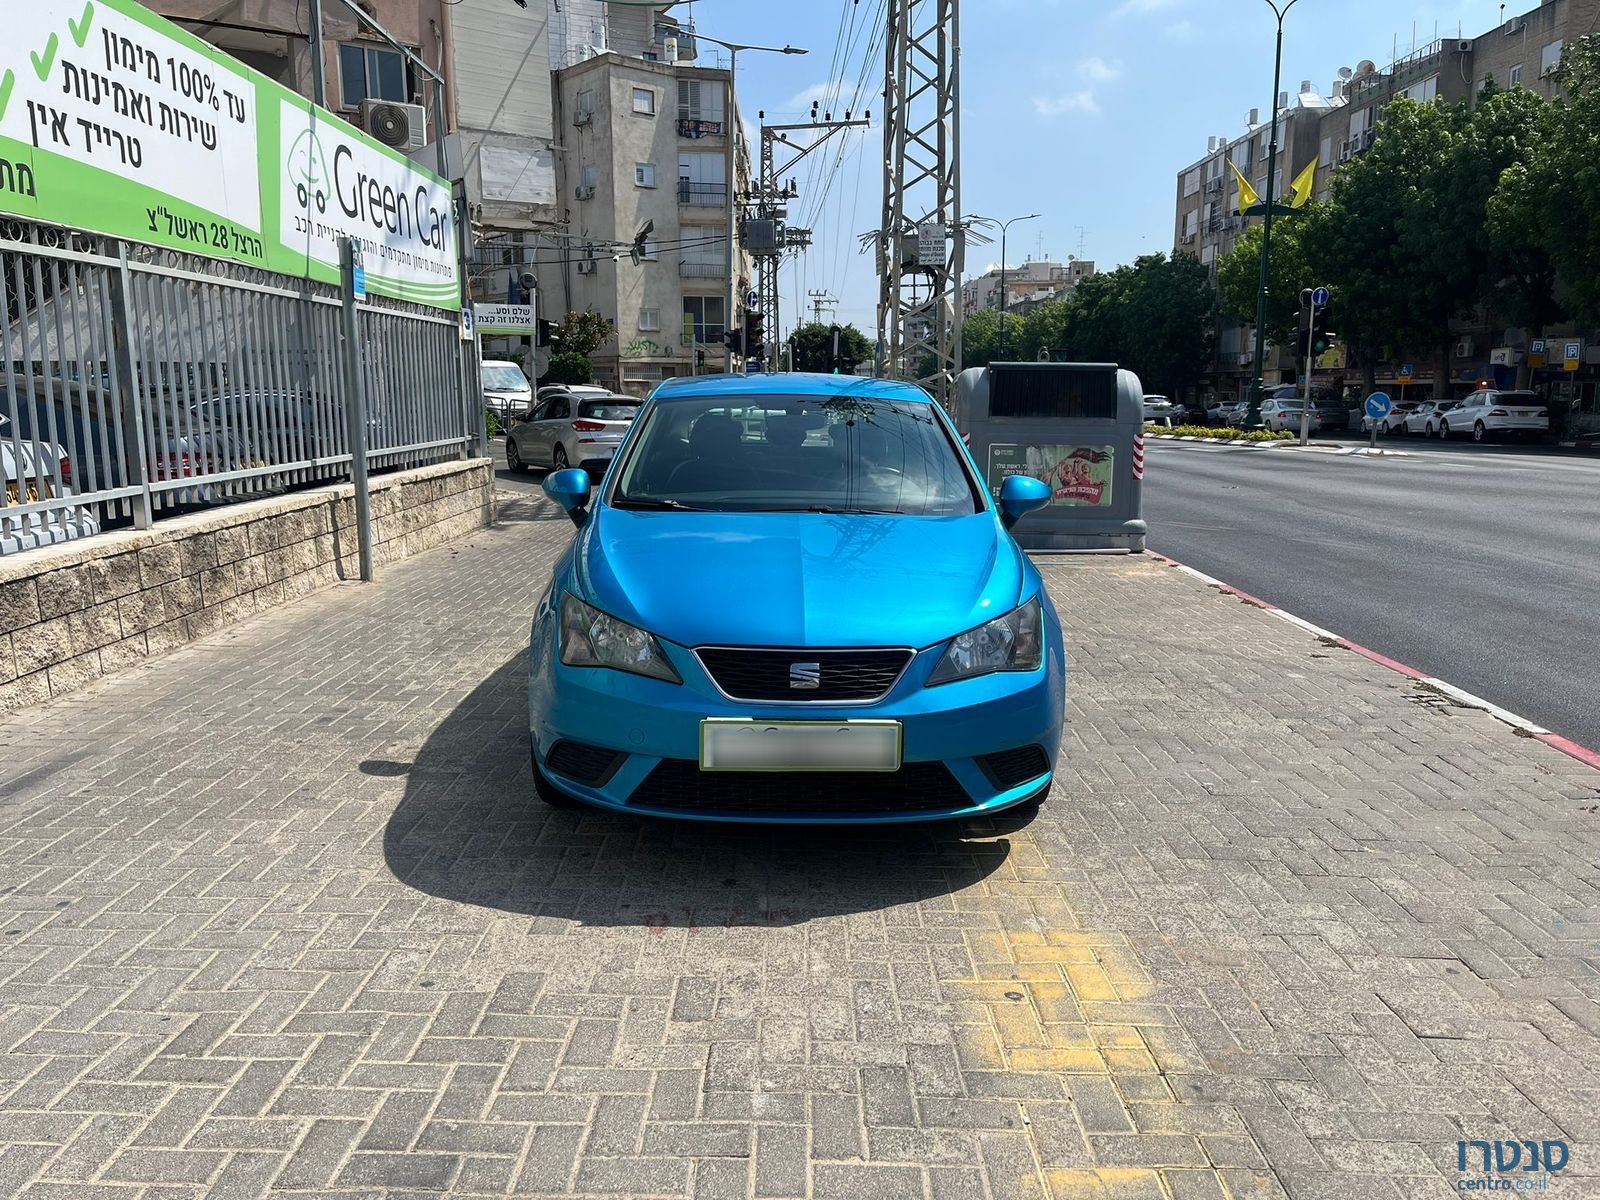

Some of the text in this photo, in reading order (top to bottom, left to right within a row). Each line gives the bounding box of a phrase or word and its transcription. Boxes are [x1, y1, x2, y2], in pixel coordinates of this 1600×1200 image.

[102, 27, 246, 123] עד 100% מימון
[61, 59, 217, 150] שירות ואמינות
[27, 99, 142, 168] טרייד אין
[334, 144, 447, 252] Green Car
[210, 222, 229, 249] 28
[295, 215, 314, 235] רכב
[231, 226, 263, 258] הרצל
[380, 244, 412, 266] מתקדמים
[413, 255, 429, 271] מימון
[478, 315, 495, 324] קצת
[488, 307, 530, 316] שלם וסע...
[497, 315, 507, 323] זה
[508, 315, 531, 324] אצלנו
